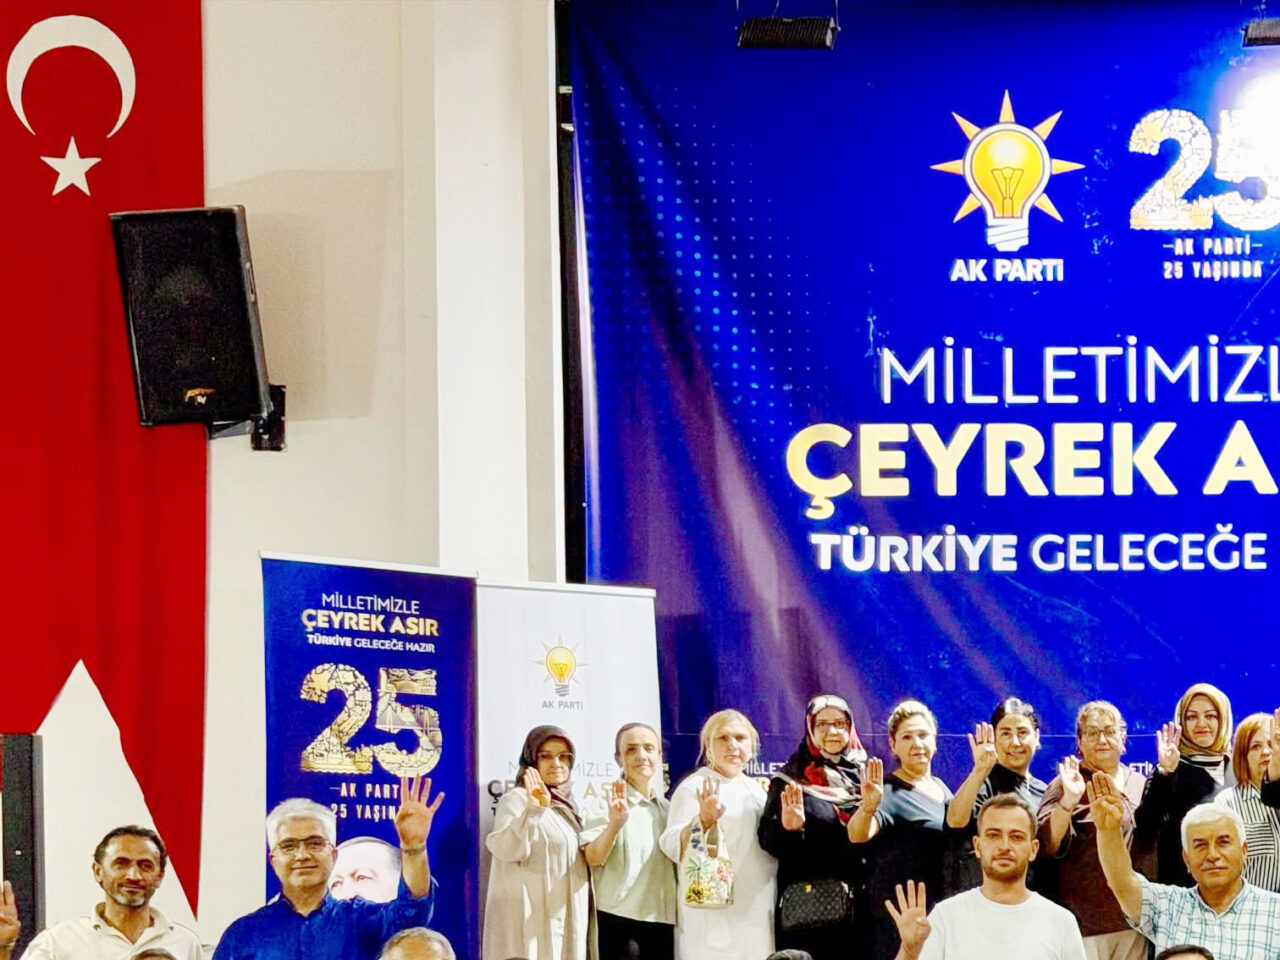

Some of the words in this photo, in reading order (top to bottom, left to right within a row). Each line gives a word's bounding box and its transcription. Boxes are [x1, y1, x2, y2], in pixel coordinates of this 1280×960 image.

[1174, 238, 1194, 255] AK
[1203, 234, 1250, 255] PARTİ
[950, 258, 987, 281] AK
[1163, 261, 1183, 279] 25
[1192, 260, 1263, 281] YAŞINDA
[786, 421, 1178, 519] ÇEYREK
[811, 524, 1018, 572] TÜRKİYE
[1032, 522, 1267, 570] GELECEĞE
[321, 591, 420, 615] MİLLETİMİZLE
[301, 608, 386, 632] ÇEYREK
[389, 616, 439, 637] ASIR
[307, 632, 352, 648] TÜRKİYE
[354, 637, 404, 652] GELECEĞE
[405, 641, 436, 654] HAZIR
[541, 700, 555, 709] AK
[300, 662, 443, 778] 25
[340, 782, 357, 798] AK
[365, 783, 400, 800] PART
[331, 802, 348, 819] 25
[356, 804, 398, 823] YAŞIN
